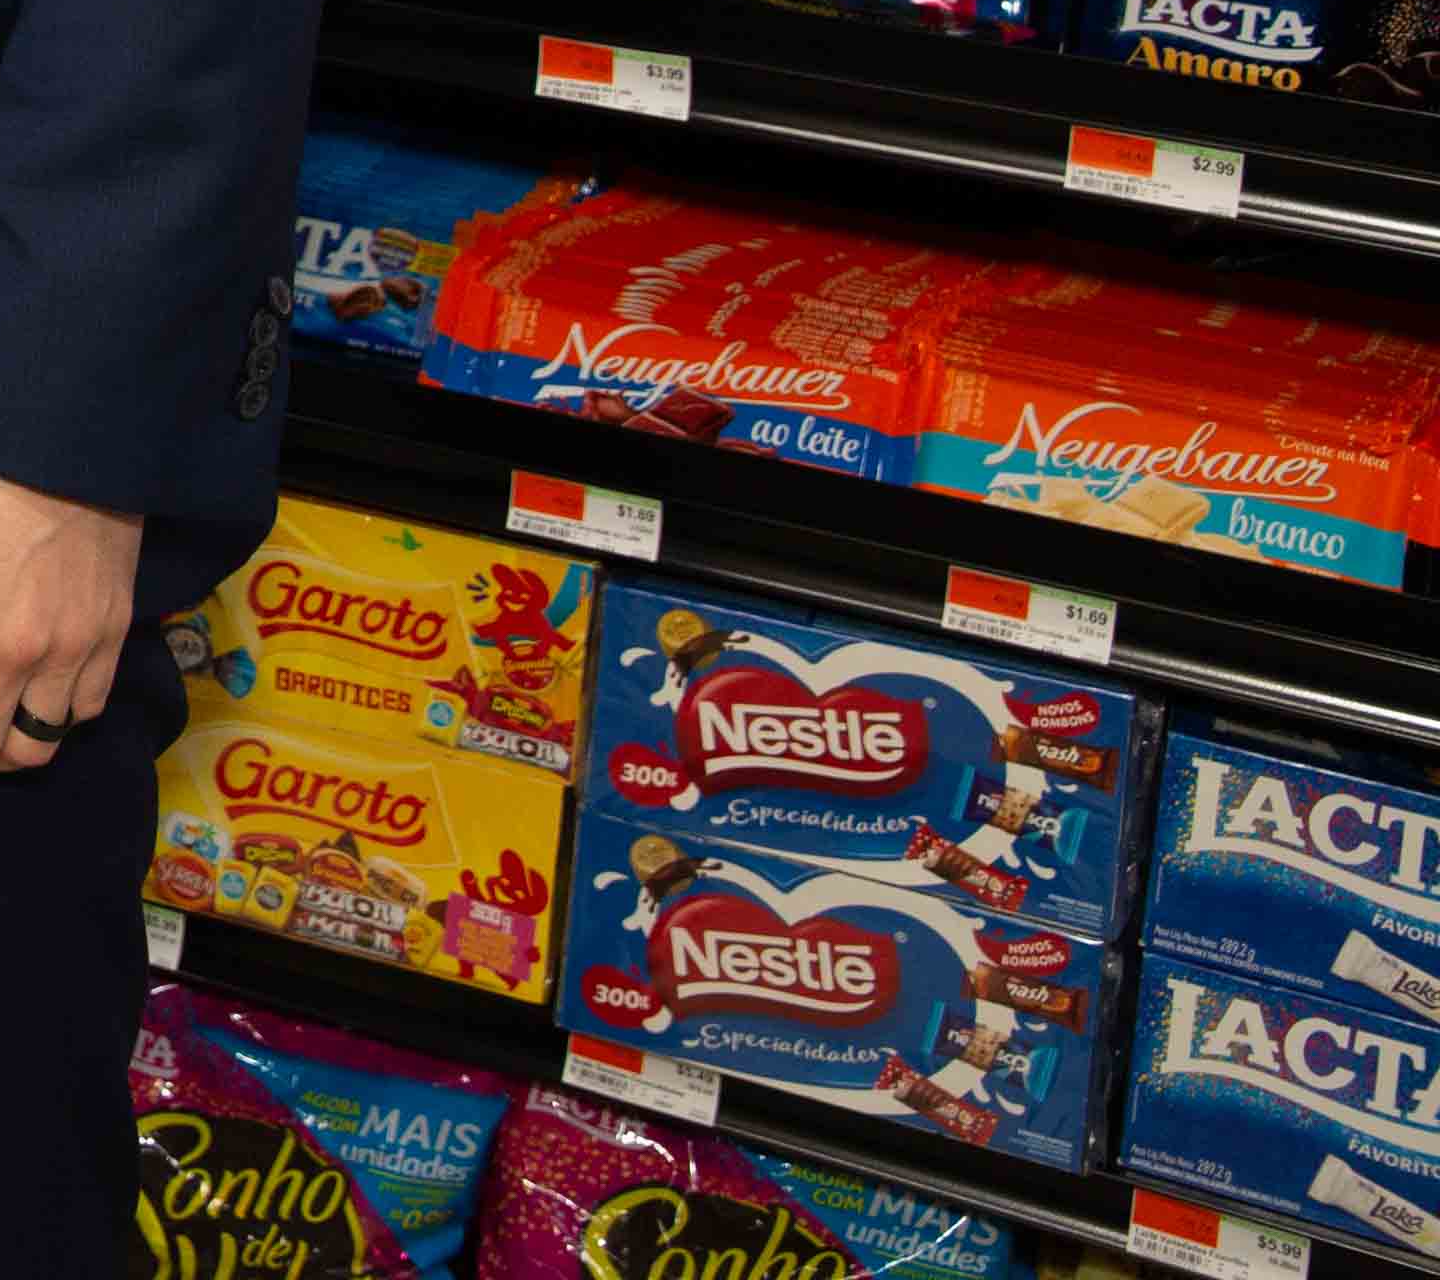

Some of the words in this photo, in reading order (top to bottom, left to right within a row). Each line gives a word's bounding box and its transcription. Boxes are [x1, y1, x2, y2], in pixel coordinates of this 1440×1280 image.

[1126, 36, 1302, 92] Amaro
[1192, 156, 1235, 177] $2.99
[530, 322, 850, 411] Neugebauer
[750, 415, 790, 447] ao
[797, 413, 861, 463] leite
[983, 401, 1337, 503] Neugebauer
[1228, 496, 1346, 561] branco
[247, 560, 447, 650] Garoto
[1065, 603, 1109, 626] $1.69
[276, 667, 413, 714] GAROTICES
[1037, 700, 1084, 717] NOVOS
[697, 700, 906, 768] Nestlé
[1030, 712, 1095, 729] BOMBONS
[214, 737, 427, 834] Garoto
[726, 797, 912, 835] Especialidades
[669, 925, 876, 1000] Nestlé
[1000, 951, 1066, 968] BOMBONS
[1007, 940, 1054, 956] NOVOS
[698, 1022, 882, 1064] Especialidades
[359, 1104, 482, 1159] MAIS
[339, 1142, 474, 1183] unidades
[812, 1187, 865, 1215] COM
[866, 1191, 999, 1246] MAIS
[1369, 1195, 1427, 1233] Laka
[845, 1220, 988, 1276] unidades
[1256, 1233, 1303, 1260] $5.99
